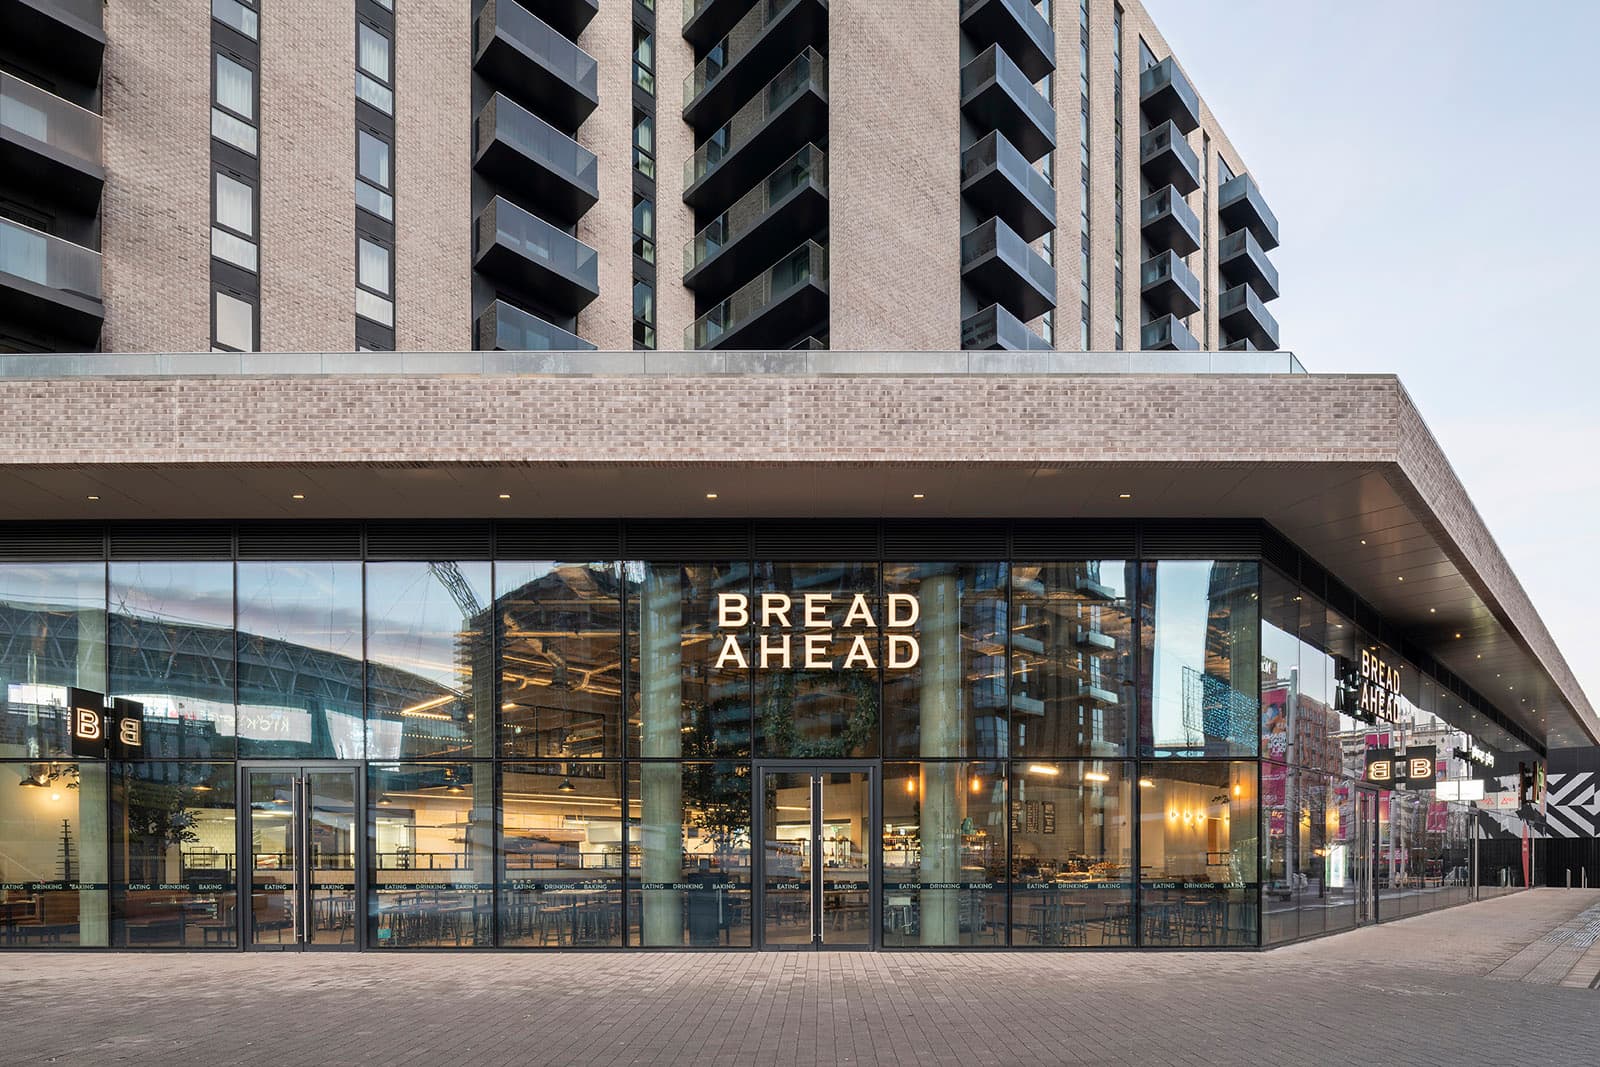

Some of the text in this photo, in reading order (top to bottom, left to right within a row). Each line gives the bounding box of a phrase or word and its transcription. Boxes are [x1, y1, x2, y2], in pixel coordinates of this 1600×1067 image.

[718, 593, 920, 628] BREAD
[714, 634, 920, 669] AHEAD
[1362, 649, 1400, 695] BREAD
[1361, 682, 1401, 724] AHEAD
[76, 707, 100, 739] B
[1410, 758, 1432, 779] B
